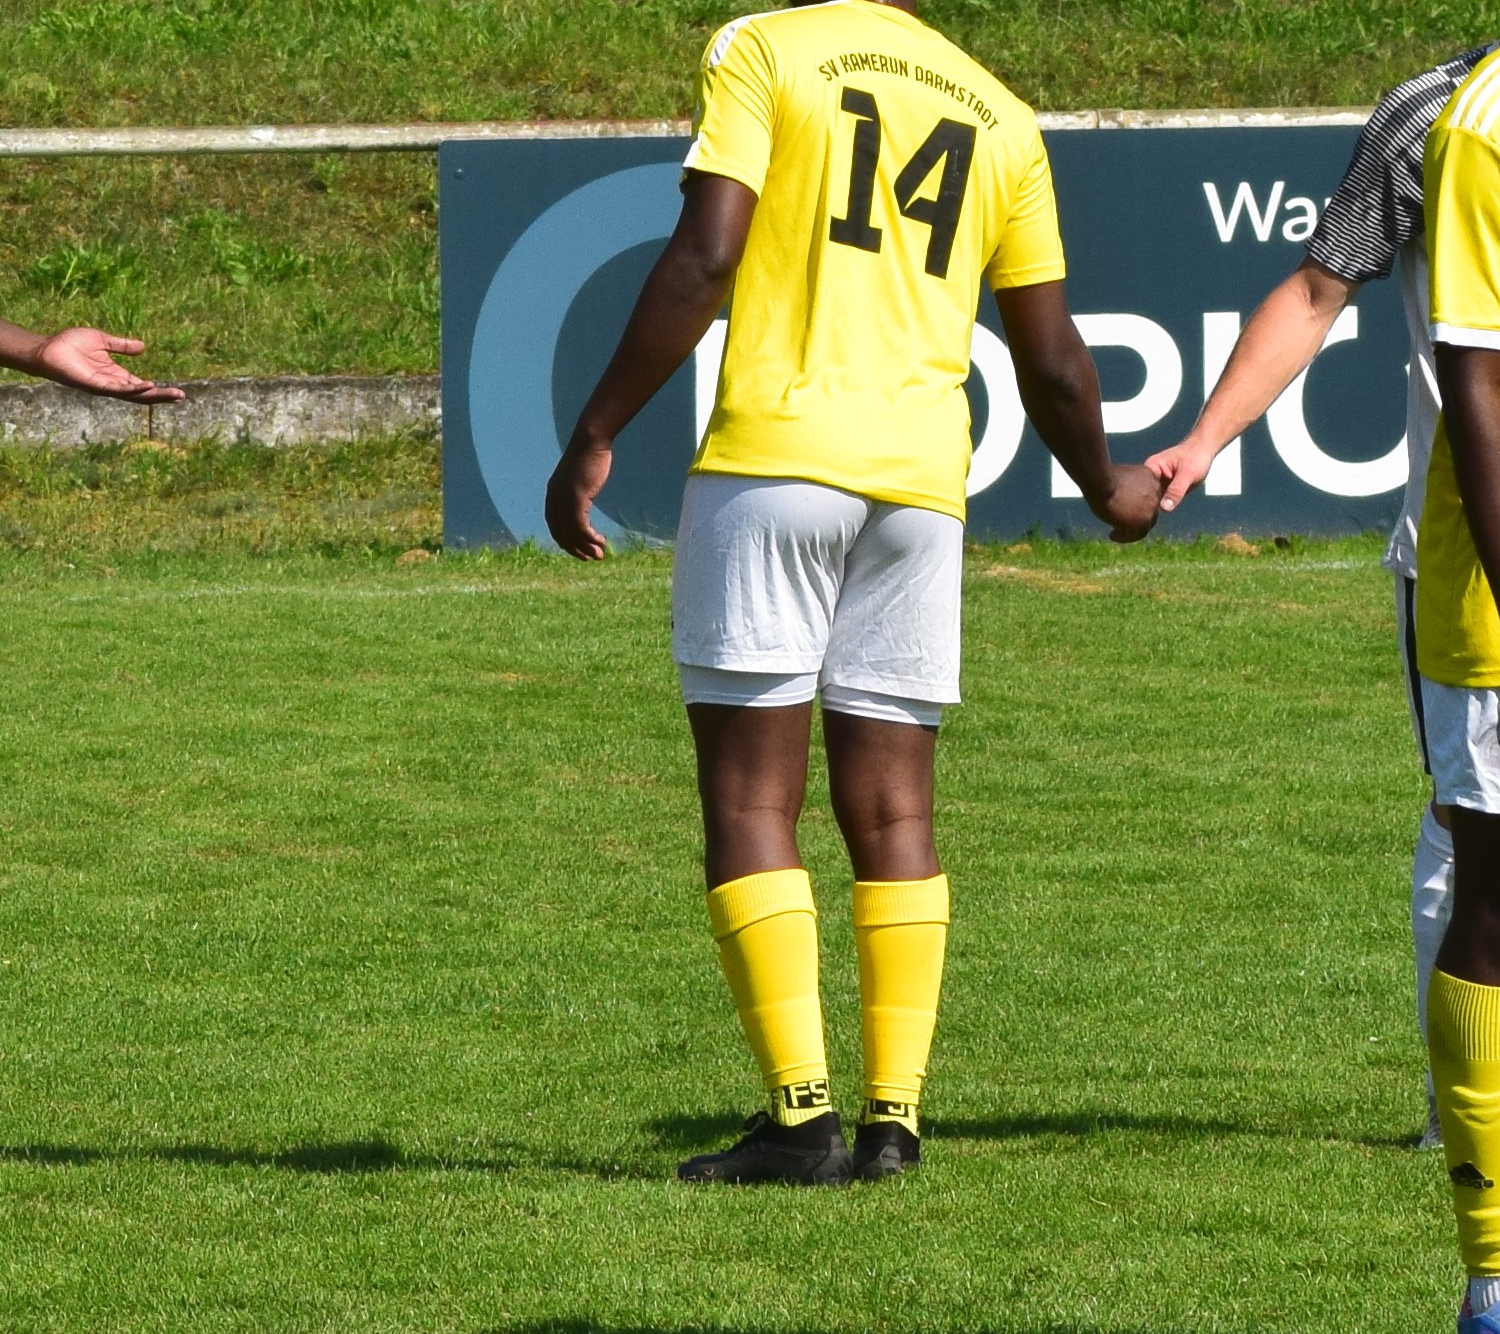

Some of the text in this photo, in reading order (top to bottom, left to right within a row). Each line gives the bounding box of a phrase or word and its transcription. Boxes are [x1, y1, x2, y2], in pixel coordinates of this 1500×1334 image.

[818, 52, 999, 131] SV KAMERUN DARMSTADT
[828, 85, 978, 280] 14
